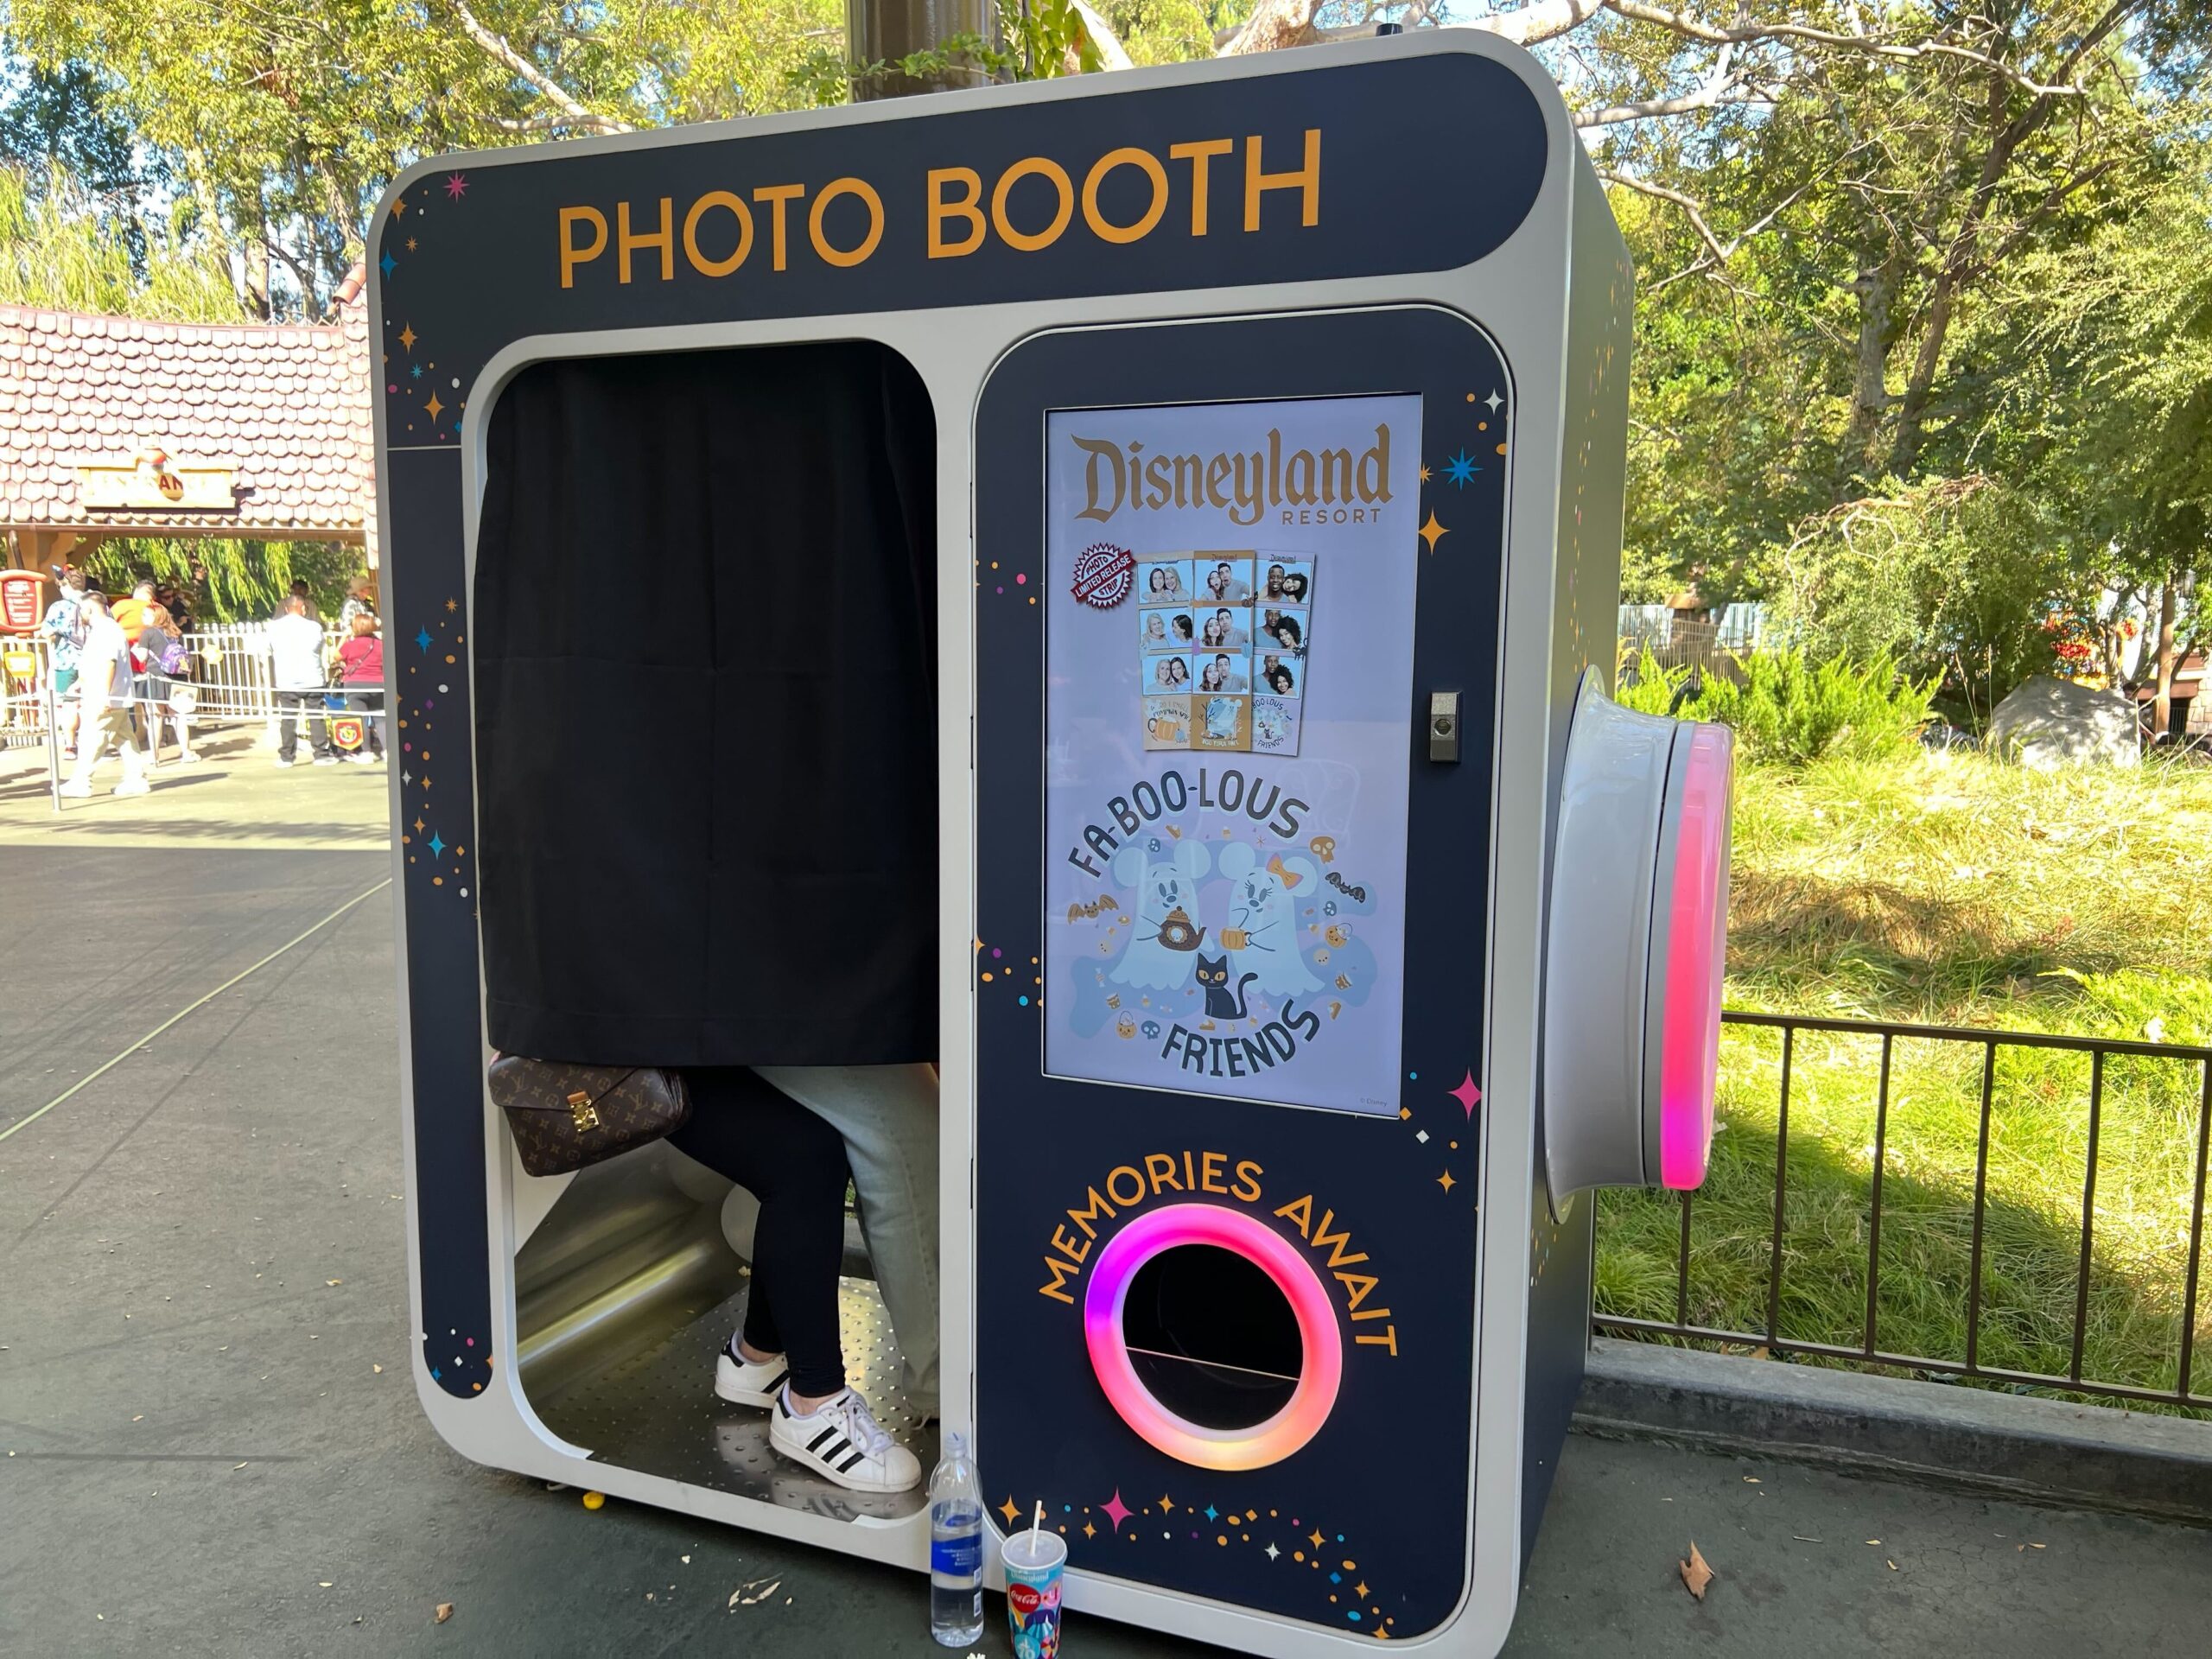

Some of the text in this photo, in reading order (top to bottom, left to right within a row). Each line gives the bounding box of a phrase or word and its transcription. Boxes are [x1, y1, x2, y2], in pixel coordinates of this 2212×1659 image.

[559, 129, 1322, 289] PHOTO BOOTH
[1071, 423, 1395, 526] Disneyland
[1282, 508, 1381, 525] RESORT
[1075, 554, 1131, 597] LIMITED RELEASE
[1086, 556, 1109, 575] PHOTO
[1098, 578, 1118, 595] STRIP
[1257, 735, 1284, 749] FRIENDS
[1068, 768, 1310, 879] FA-BOO-LOUS
[1161, 999, 1320, 1077] FRIENDS
[1039, 1150, 1398, 1357] MEMORIES AWAIT
